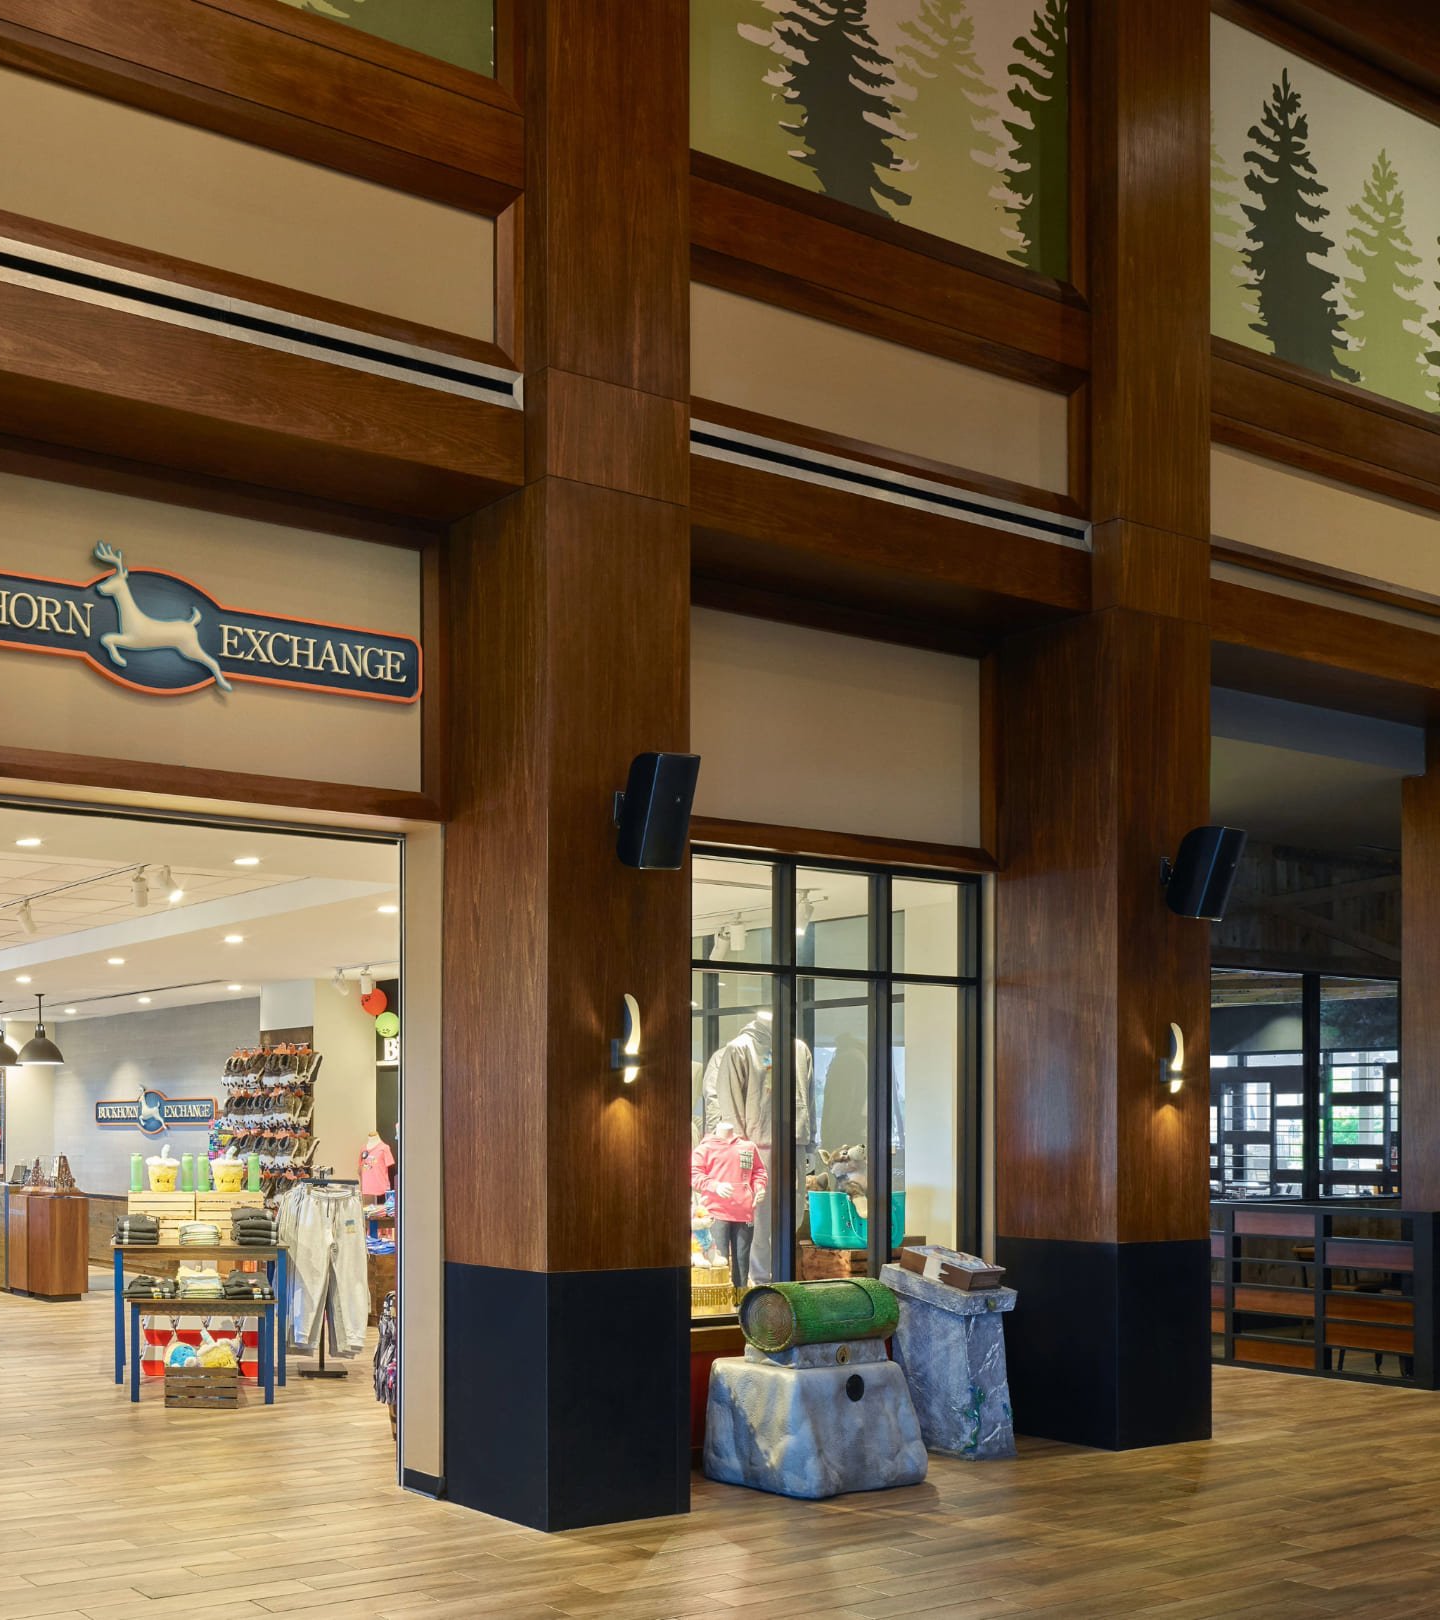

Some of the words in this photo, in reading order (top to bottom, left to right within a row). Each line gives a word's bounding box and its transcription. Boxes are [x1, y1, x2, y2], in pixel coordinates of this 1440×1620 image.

[218, 624, 407, 683] EXCHANGE
[98, 1106, 138, 1119] BUCKHORN
[164, 1104, 211, 1117] EXCHANGE
